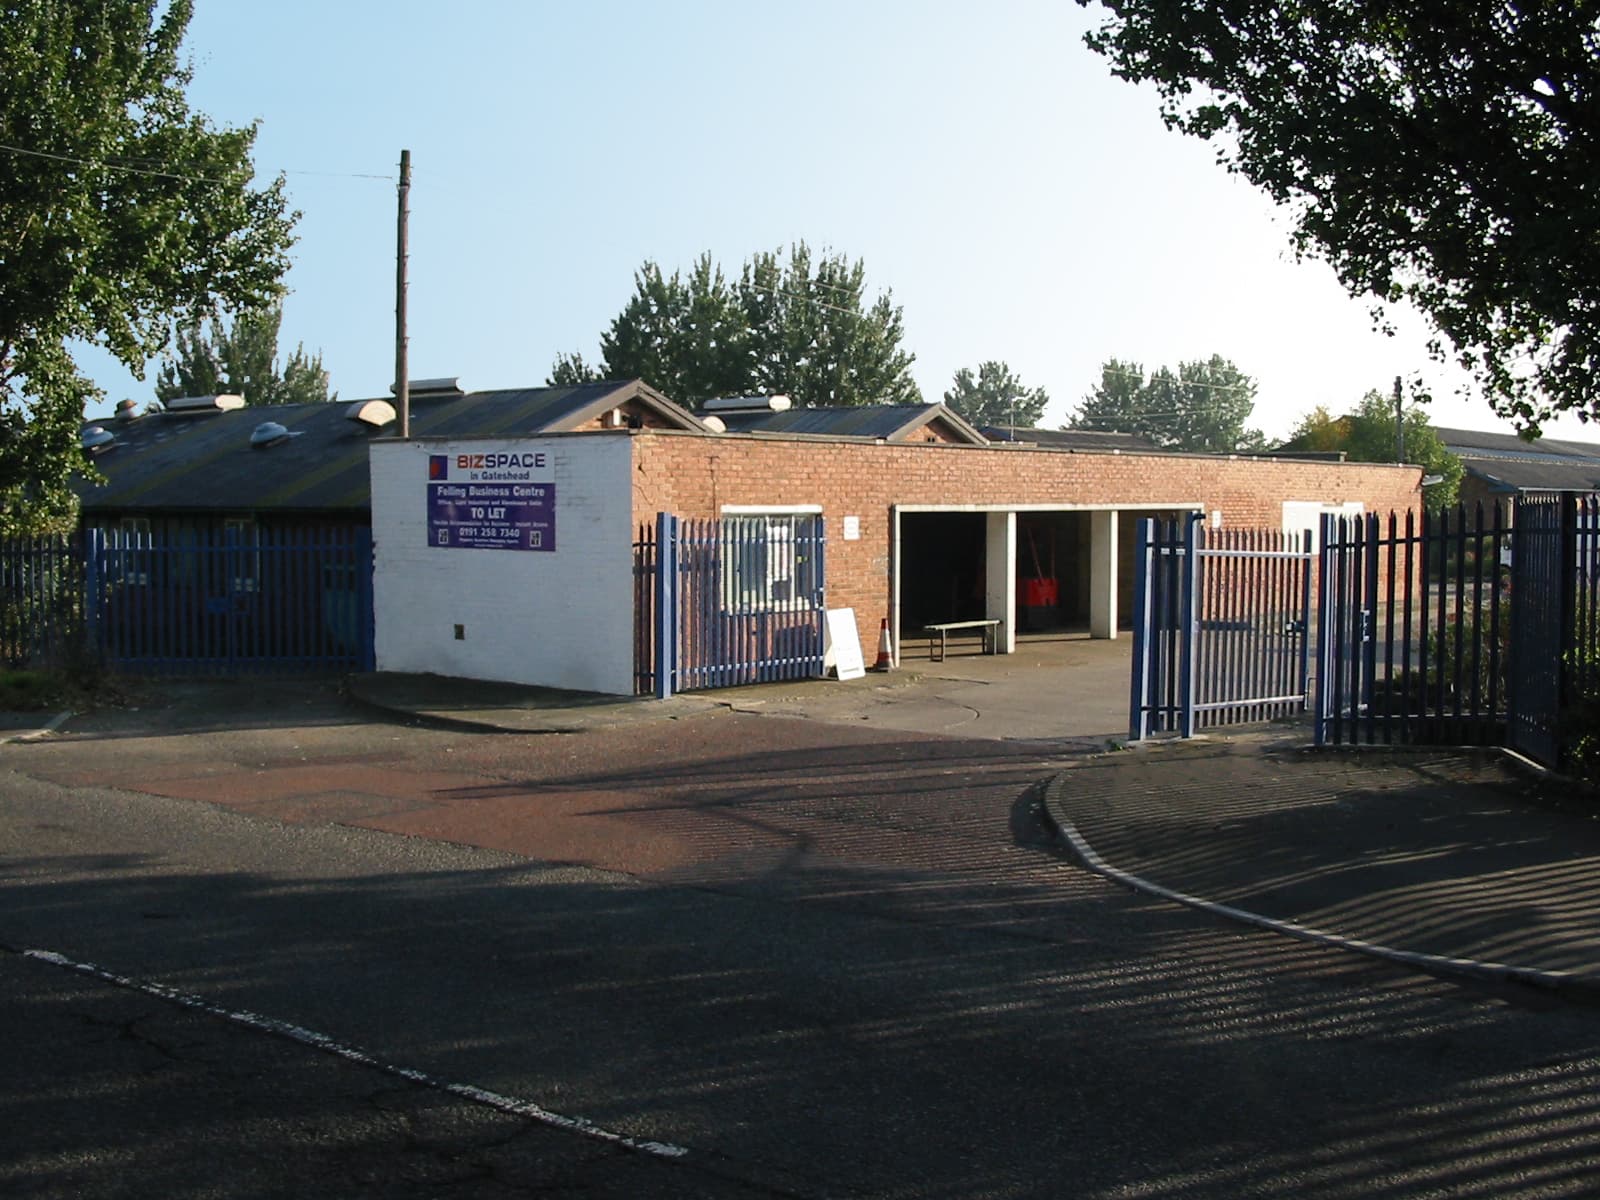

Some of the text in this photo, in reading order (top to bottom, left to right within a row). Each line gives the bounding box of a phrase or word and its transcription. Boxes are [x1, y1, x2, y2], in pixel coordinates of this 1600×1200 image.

[457, 453, 546, 469] BIZSPACE
[481, 471, 530, 480] Gateshead
[437, 486, 545, 498] Felling Business Centre
[471, 507, 506, 519] TO LET
[459, 527, 478, 536] 0191
